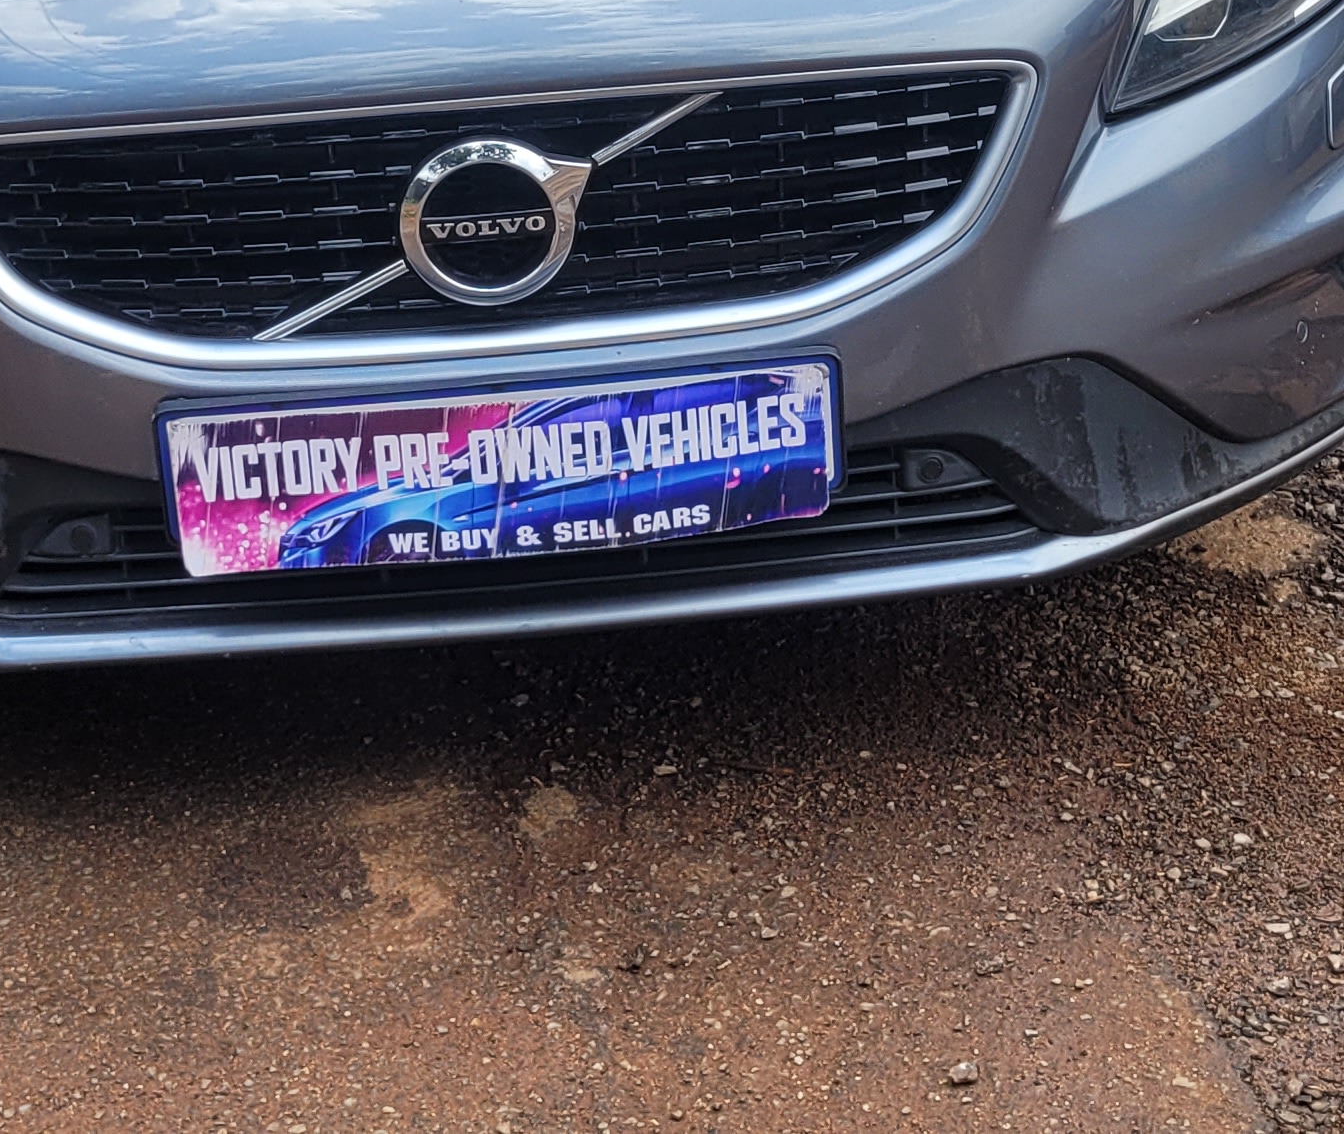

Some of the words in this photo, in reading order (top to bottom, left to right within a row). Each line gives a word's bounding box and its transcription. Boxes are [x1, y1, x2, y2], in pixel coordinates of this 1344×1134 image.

[426, 216, 546, 239] VOLVO
[190, 436, 362, 503] VICTORY
[373, 420, 613, 491] PRE-OWNED
[622, 393, 806, 472] VEHICLES
[389, 532, 429, 553] WE
[441, 527, 498, 551] BUY
[516, 525, 542, 546] &
[553, 518, 621, 543] SELL
[633, 504, 711, 535] CARS
